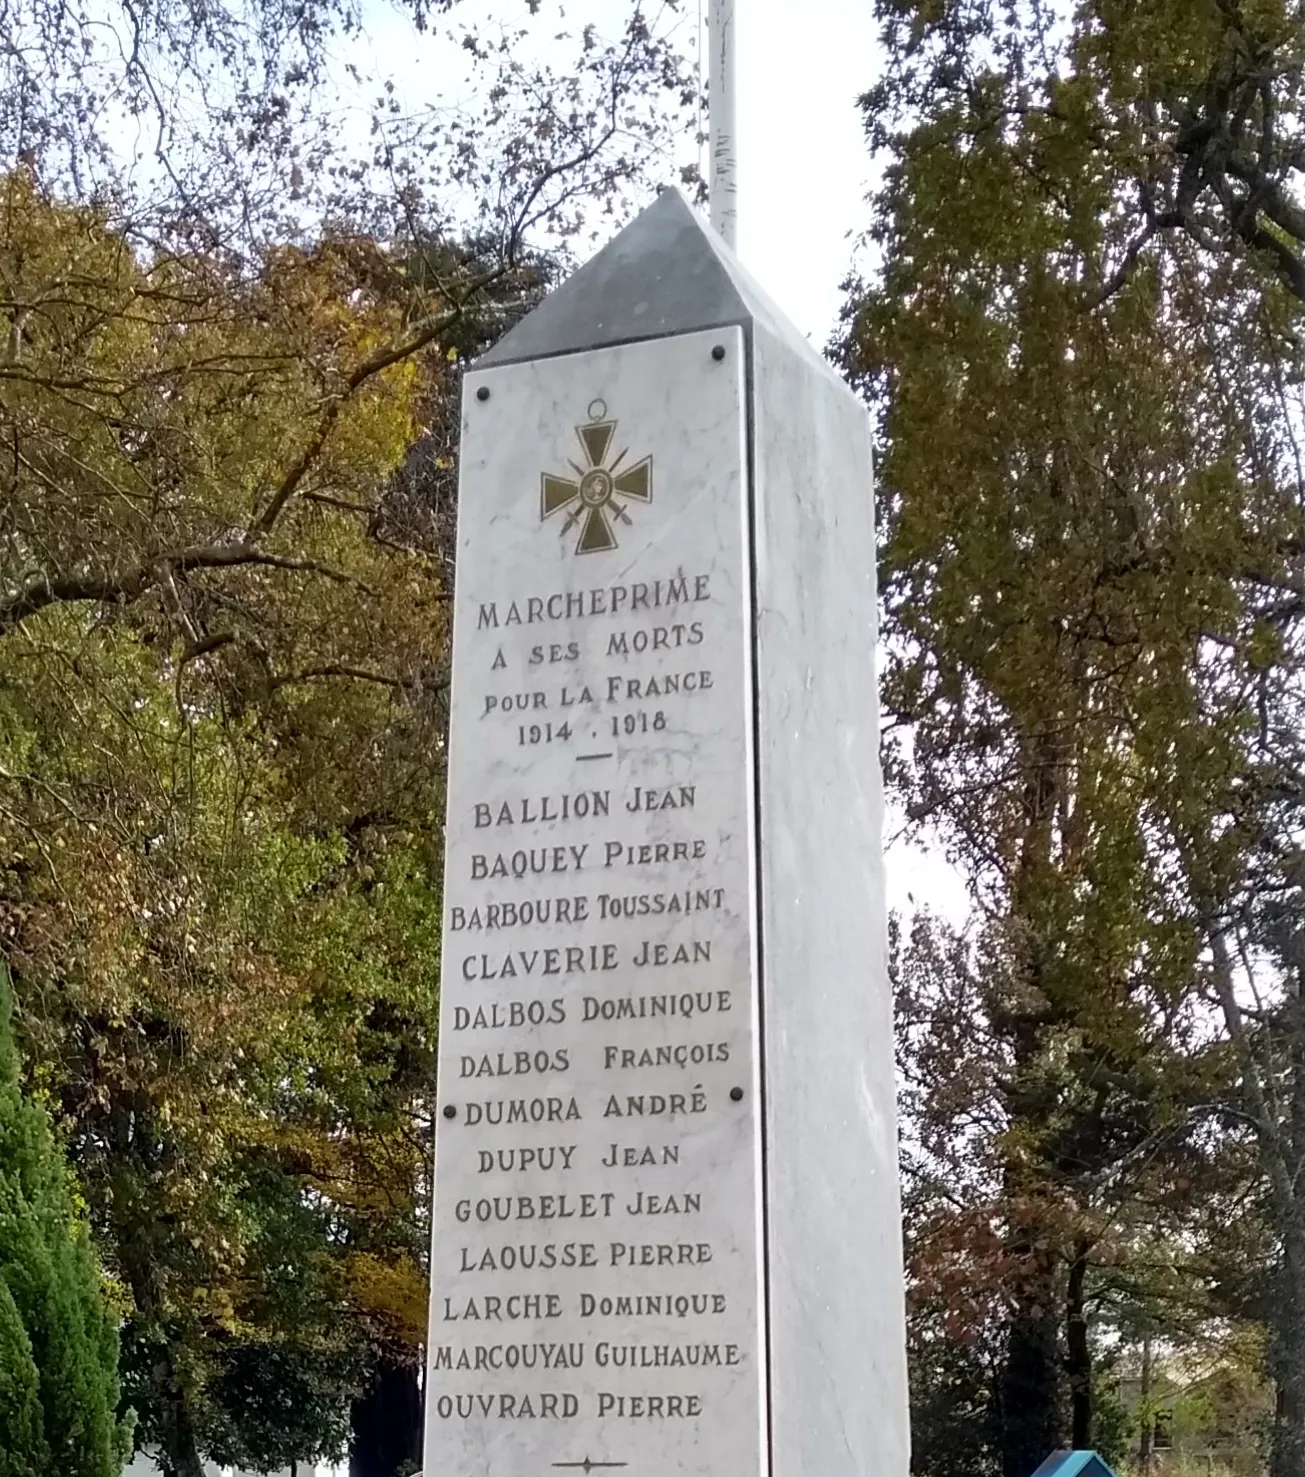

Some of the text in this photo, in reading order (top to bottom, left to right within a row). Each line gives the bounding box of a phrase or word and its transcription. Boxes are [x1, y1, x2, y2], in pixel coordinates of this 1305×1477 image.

[477, 574, 711, 629] MARCHEPRIME
[491, 622, 704, 670] A SES MORTS
[485, 671, 714, 713] POUR LA FRANCE
[519, 721, 572, 745] 1914
[611, 711, 666, 736] 1918
[474, 786, 697, 828] BALLION JEAN
[470, 840, 706, 880] BAQUEY PIERRE
[450, 888, 725, 931] BARBOURE TOUSSAINT
[462, 941, 711, 981] CLAVERIE JEAN
[453, 990, 732, 1031] DALBOS DOMINIQUE
[460, 1042, 730, 1078] DALBOS FRANÇOIS
[463, 1084, 708, 1126] DUMORA ANDRÉ
[478, 1144, 680, 1173] DUPUY JEAN
[455, 1192, 702, 1222] GOUBELET JEAN
[460, 1242, 712, 1272] LAOUSSE PIERRE
[443, 1294, 726, 1321] LARCHE DOMINIQUE
[433, 1342, 740, 1370] MARCOUYAU GUILHAUME
[437, 1393, 703, 1419] OUVRARD PIERRE
